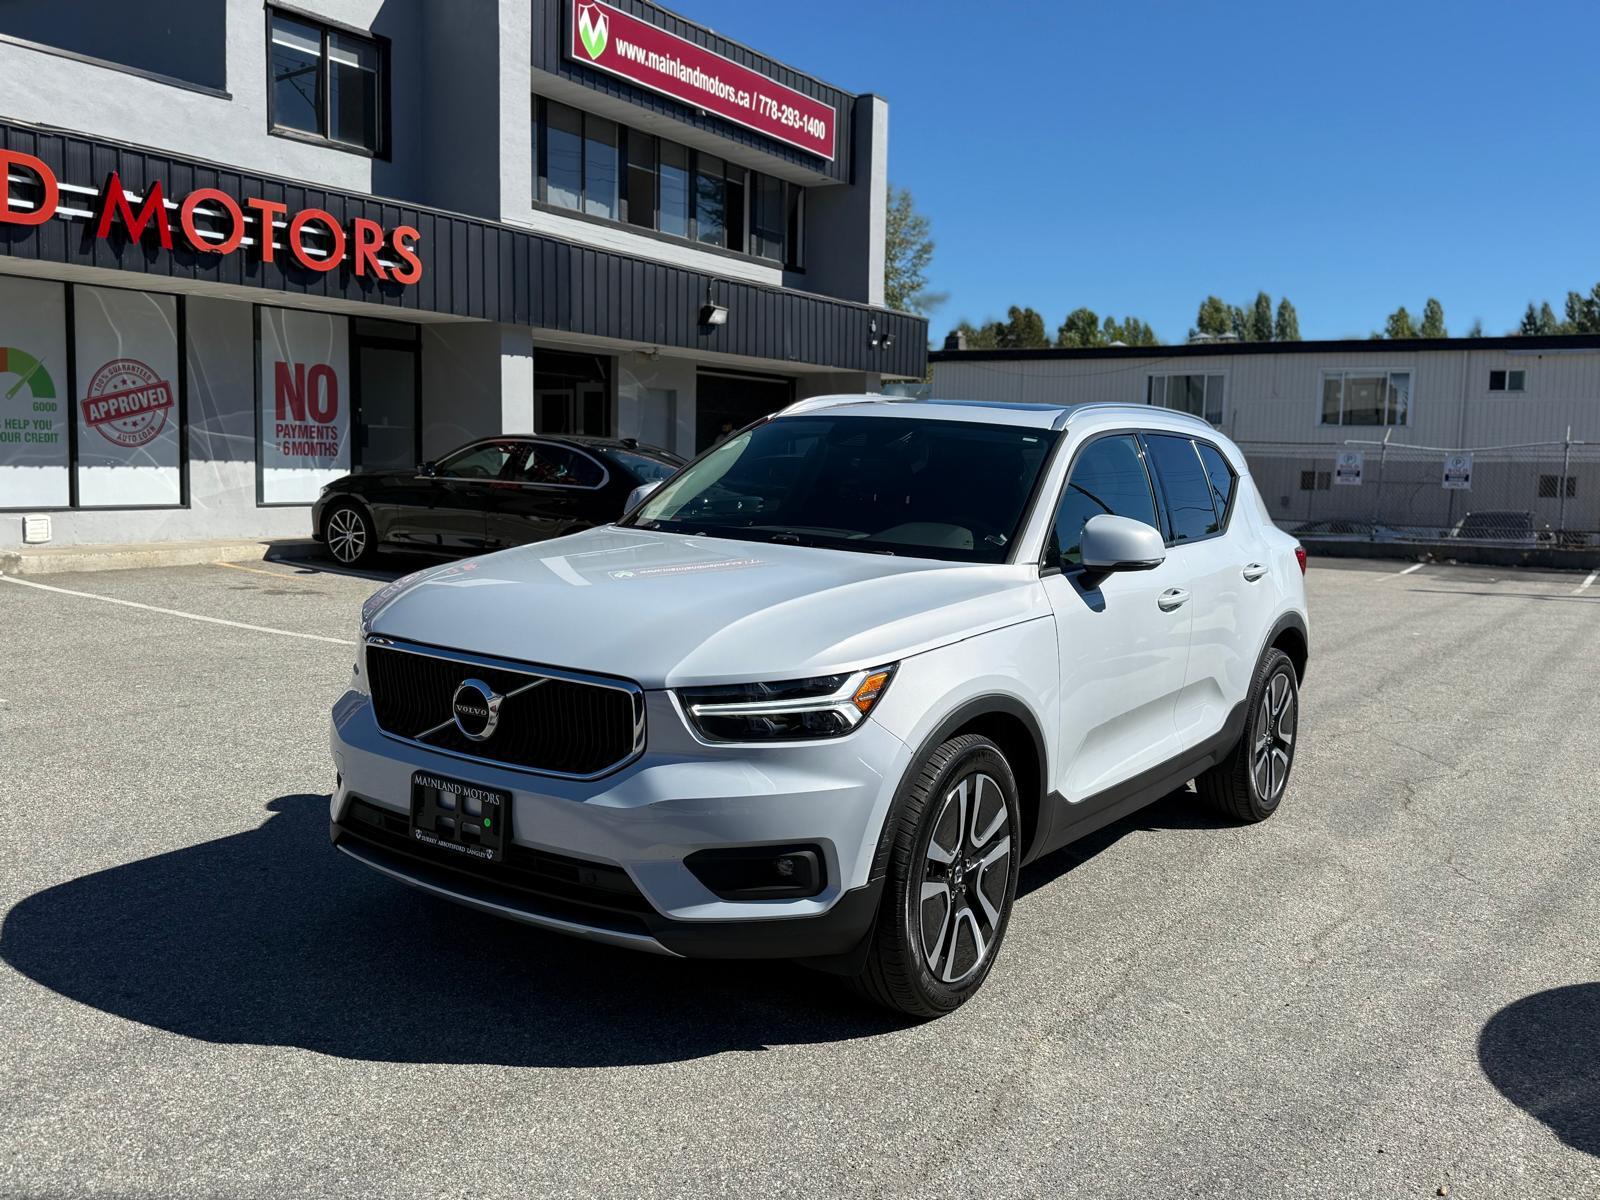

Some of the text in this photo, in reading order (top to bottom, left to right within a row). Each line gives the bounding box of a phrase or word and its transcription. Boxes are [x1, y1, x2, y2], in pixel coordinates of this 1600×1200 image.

[615, 38, 826, 140] www.mainlandmotors.ca / 778-293-1400
[97, 170, 424, 285] MOTORS
[108, 363, 153, 381] GUARANTEED
[274, 361, 339, 424] NO
[32, 402, 58, 412] GOOD
[89, 387, 168, 421] APPROVED
[4, 418, 30, 430] HELP
[32, 419, 53, 431] YOU
[275, 424, 339, 441] PAYMENTS
[24, 431, 59, 443] CREDIT
[116, 425, 157, 443] AUTO LOAN
[283, 441, 291, 456] 6
[291, 441, 338, 457] MONTHS
[456, 704, 487, 716] VOLVO
[414, 775, 500, 806] MAINLAND MOTORS
